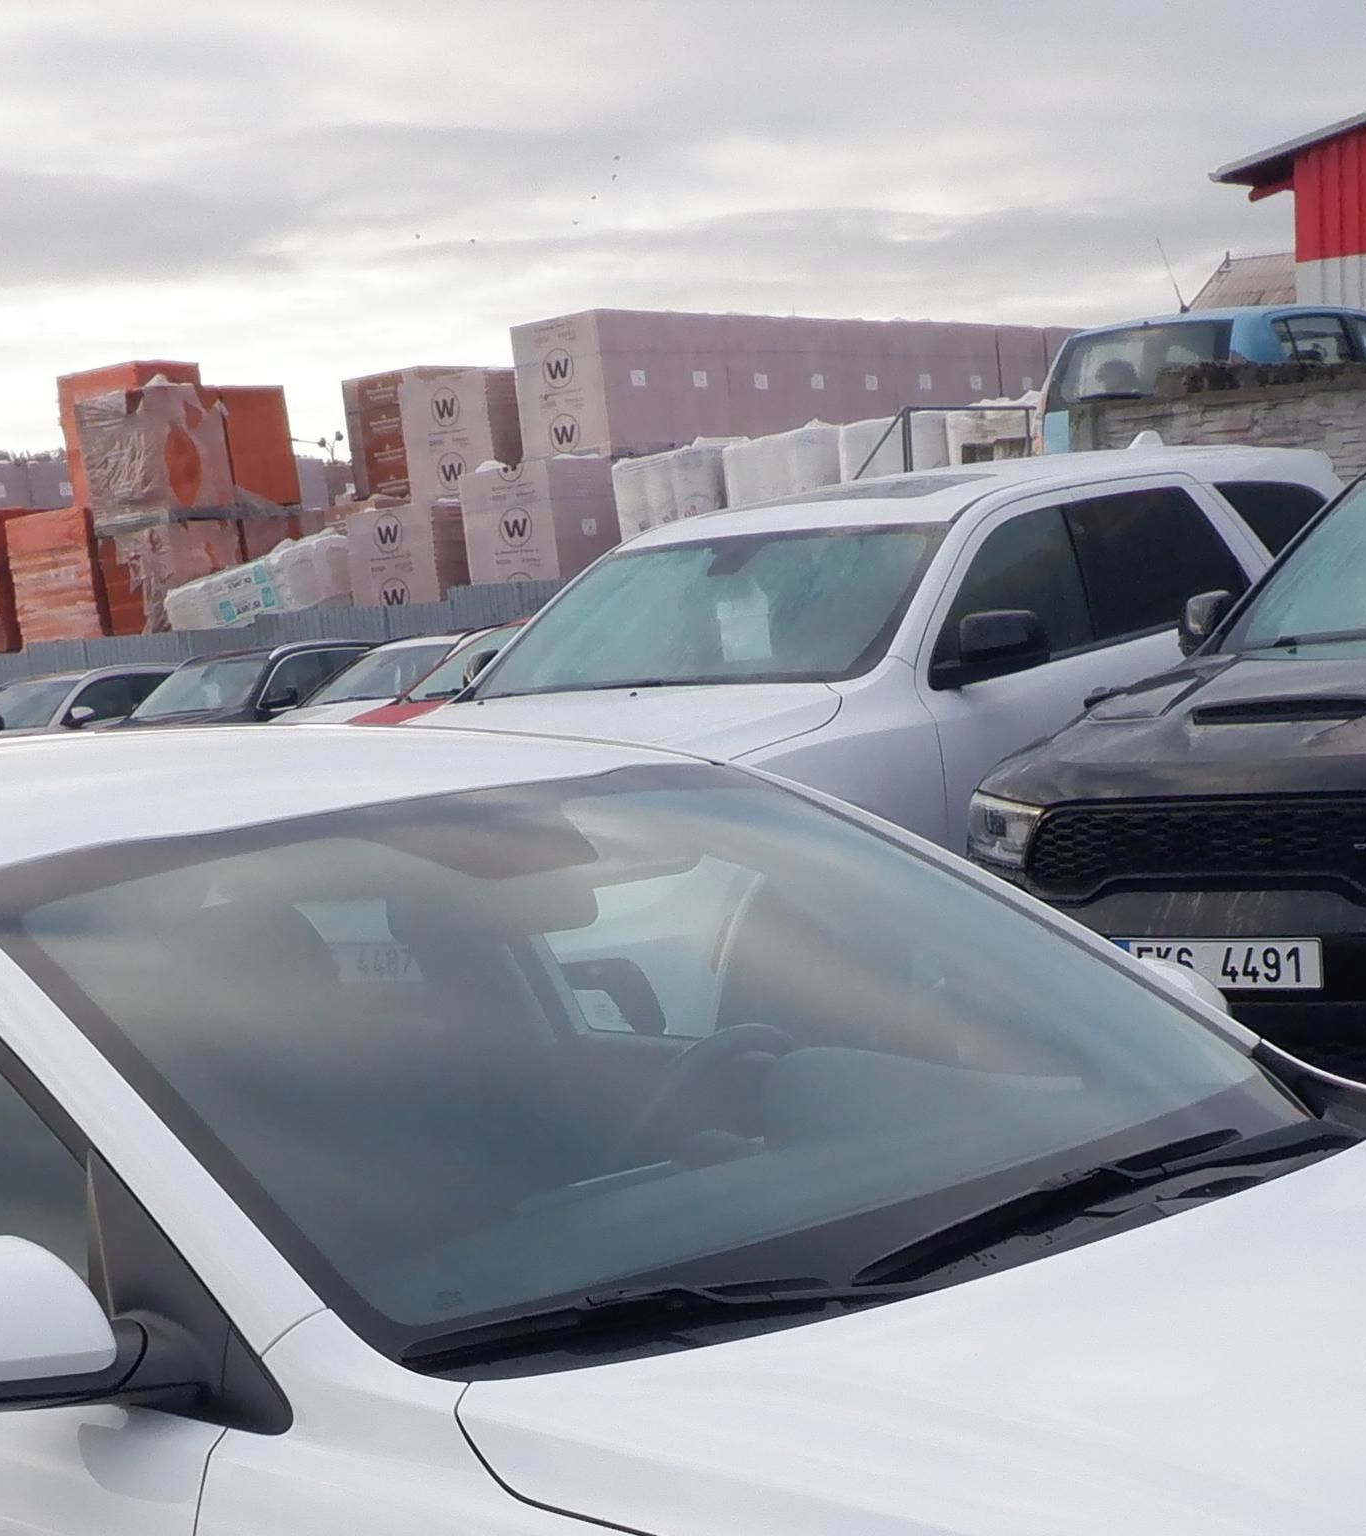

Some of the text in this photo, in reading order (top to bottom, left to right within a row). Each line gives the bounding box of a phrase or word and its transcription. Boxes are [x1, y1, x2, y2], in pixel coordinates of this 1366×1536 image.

[546, 358, 569, 380] W
[435, 398, 455, 419] W
[553, 424, 575, 445] W
[441, 463, 462, 482] W
[378, 524, 398, 544] W
[503, 518, 527, 538] W
[383, 588, 405, 606] W
[1221, 946, 1302, 984] 4491
